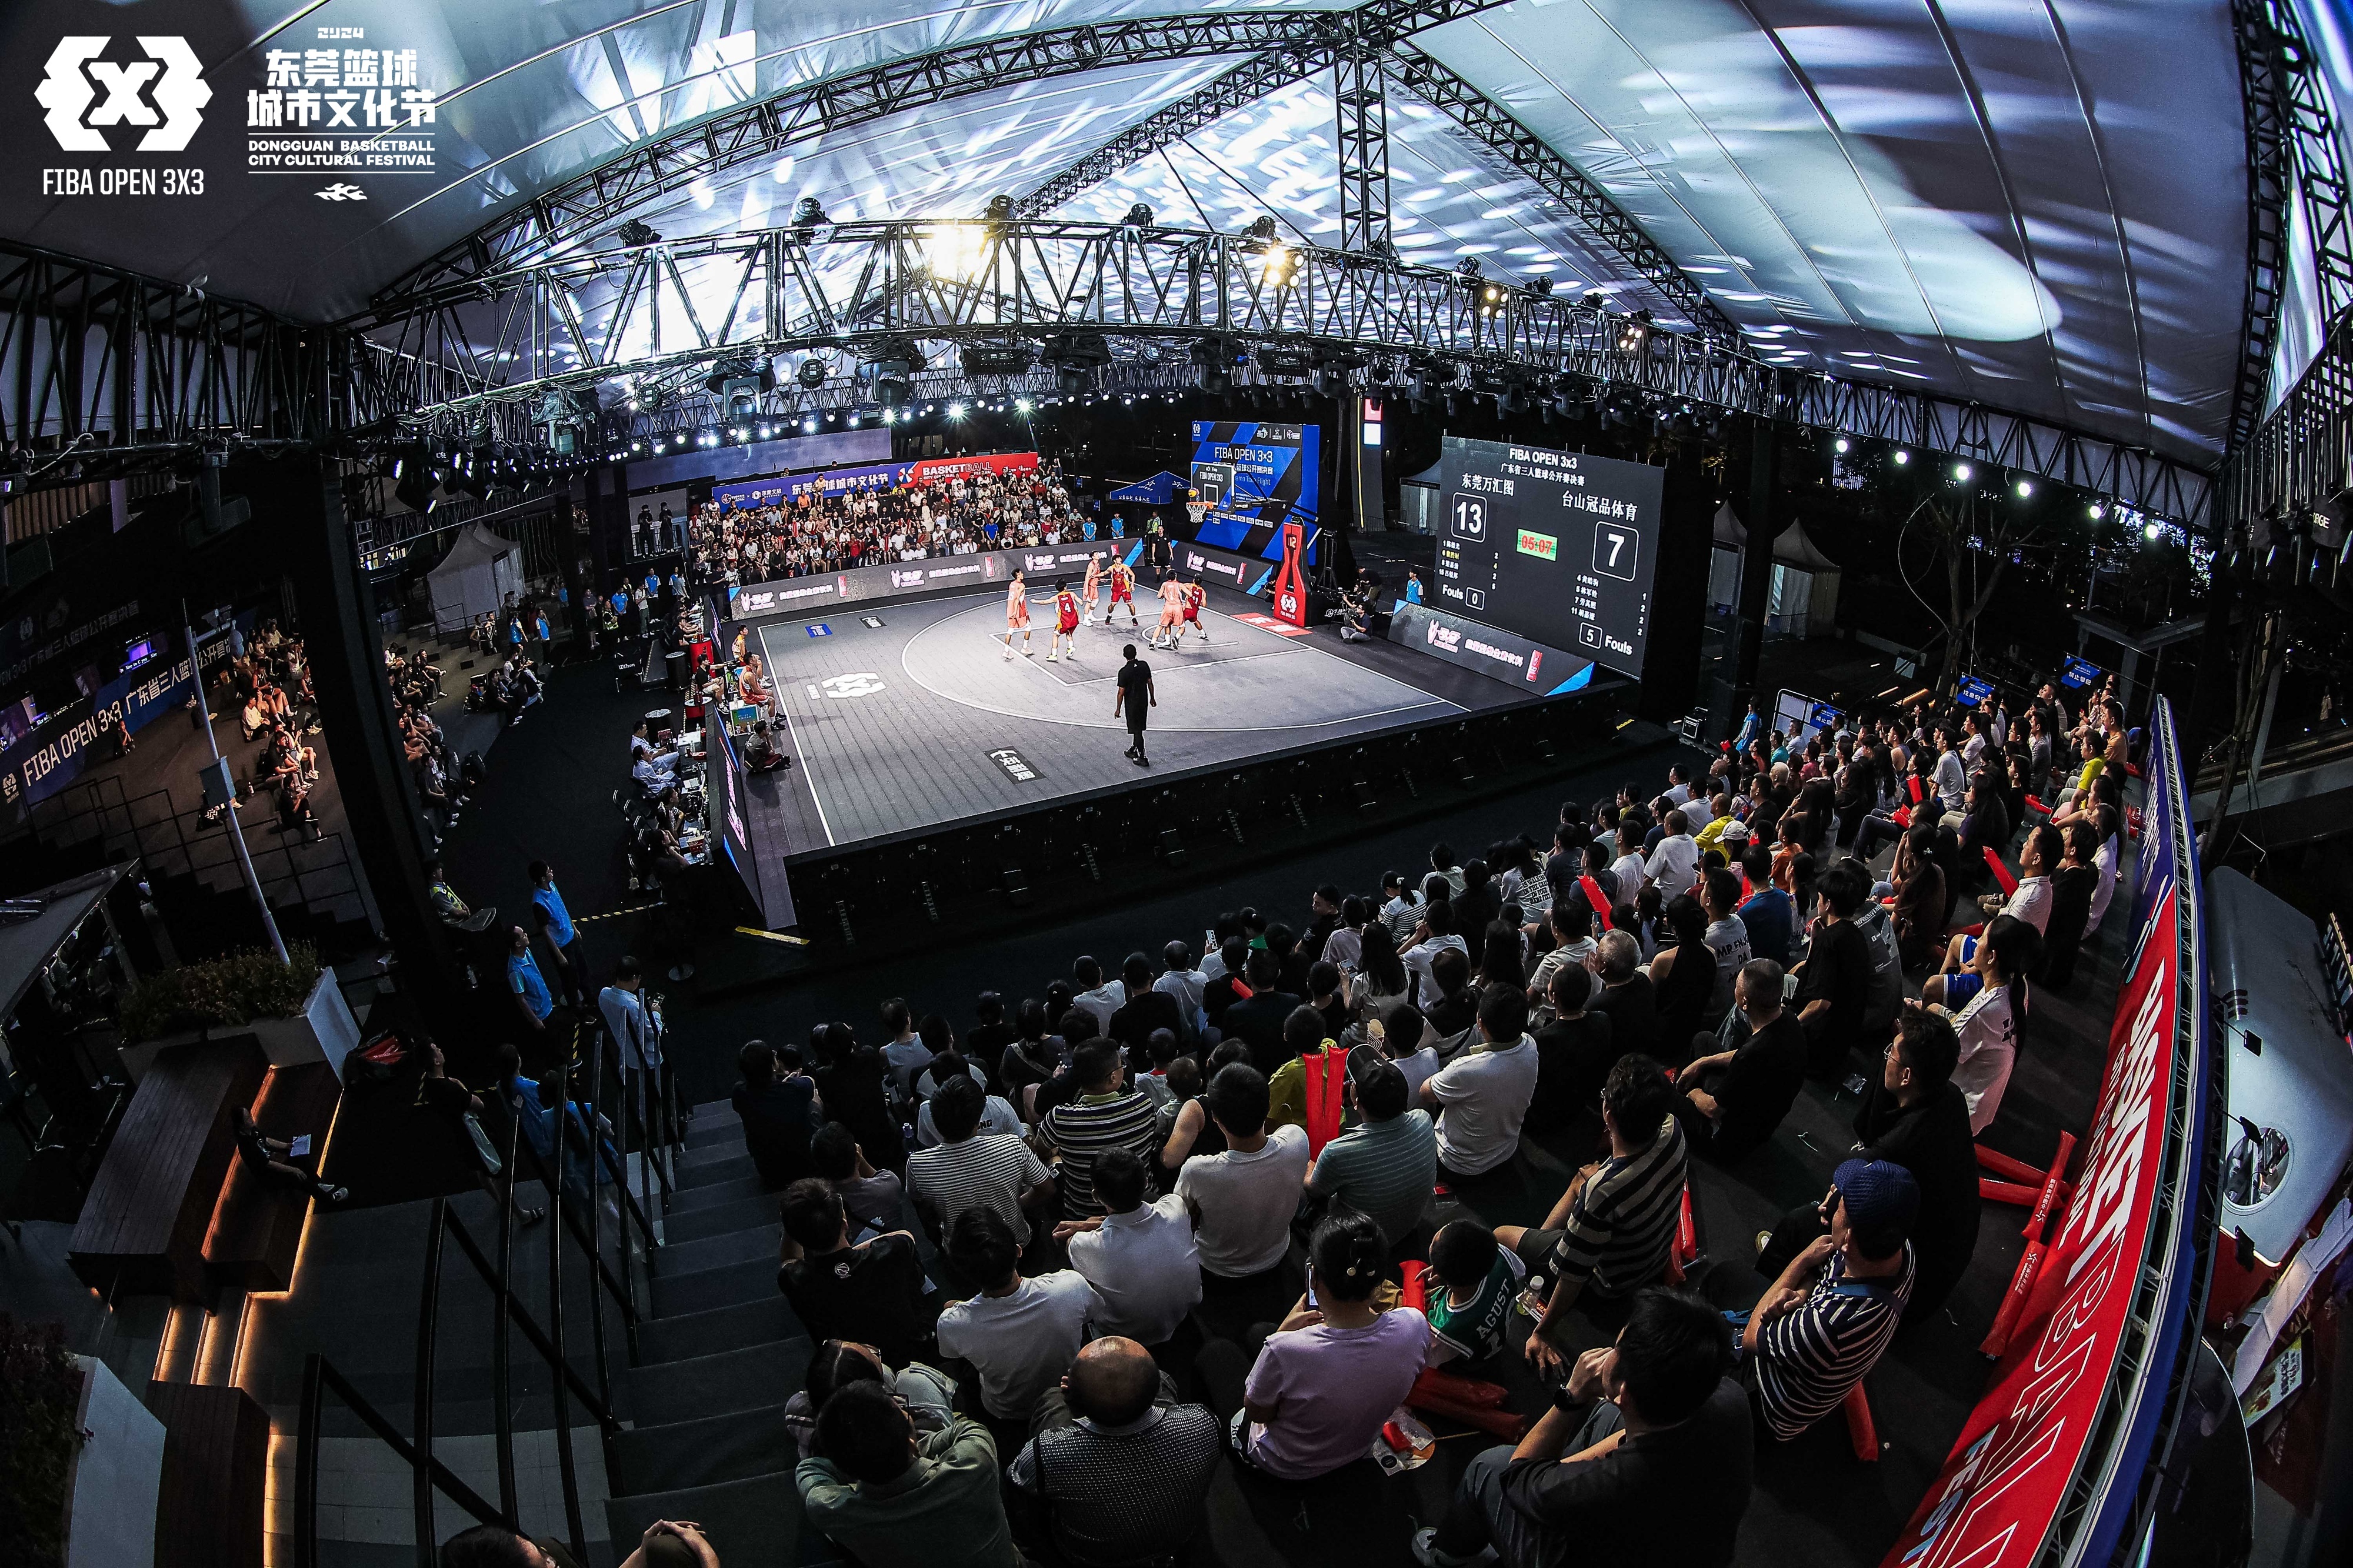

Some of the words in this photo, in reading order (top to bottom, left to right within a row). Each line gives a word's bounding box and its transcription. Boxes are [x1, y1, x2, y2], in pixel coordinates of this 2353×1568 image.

[1215, 446, 1233, 459] FIBA
[1234, 448, 1255, 462] OPEN
[1509, 448, 1531, 462] FIBA
[1532, 452, 1559, 466] OPEN
[922, 462, 993, 476] BASKETBALL
[1500, 462, 1585, 487] 广东省三人篮球公开赛决赛
[791, 472, 889, 496] 东莞球城市文化节
[1257, 477, 1271, 486] Flight
[1461, 472, 1515, 496] 东莞万汇图
[1457, 501, 1482, 533] 13
[1562, 490, 1638, 522] 台山冠品体育
[1608, 533, 1625, 568] 7
[1442, 584, 1464, 600] Fouls
[1472, 593, 1478, 605] 0
[1064, 602, 1071, 613] 4
[1587, 629, 1594, 642] 5
[1605, 635, 1632, 655] Fouls
[23, 743, 61, 787] FIBA
[60, 716, 98, 759] OPEN
[2057, 1091, 2117, 1251] CULTURAL
[2041, 1177, 2057, 1210] 中国体育彩票
[1477, 1278, 1510, 1339] AGUST
